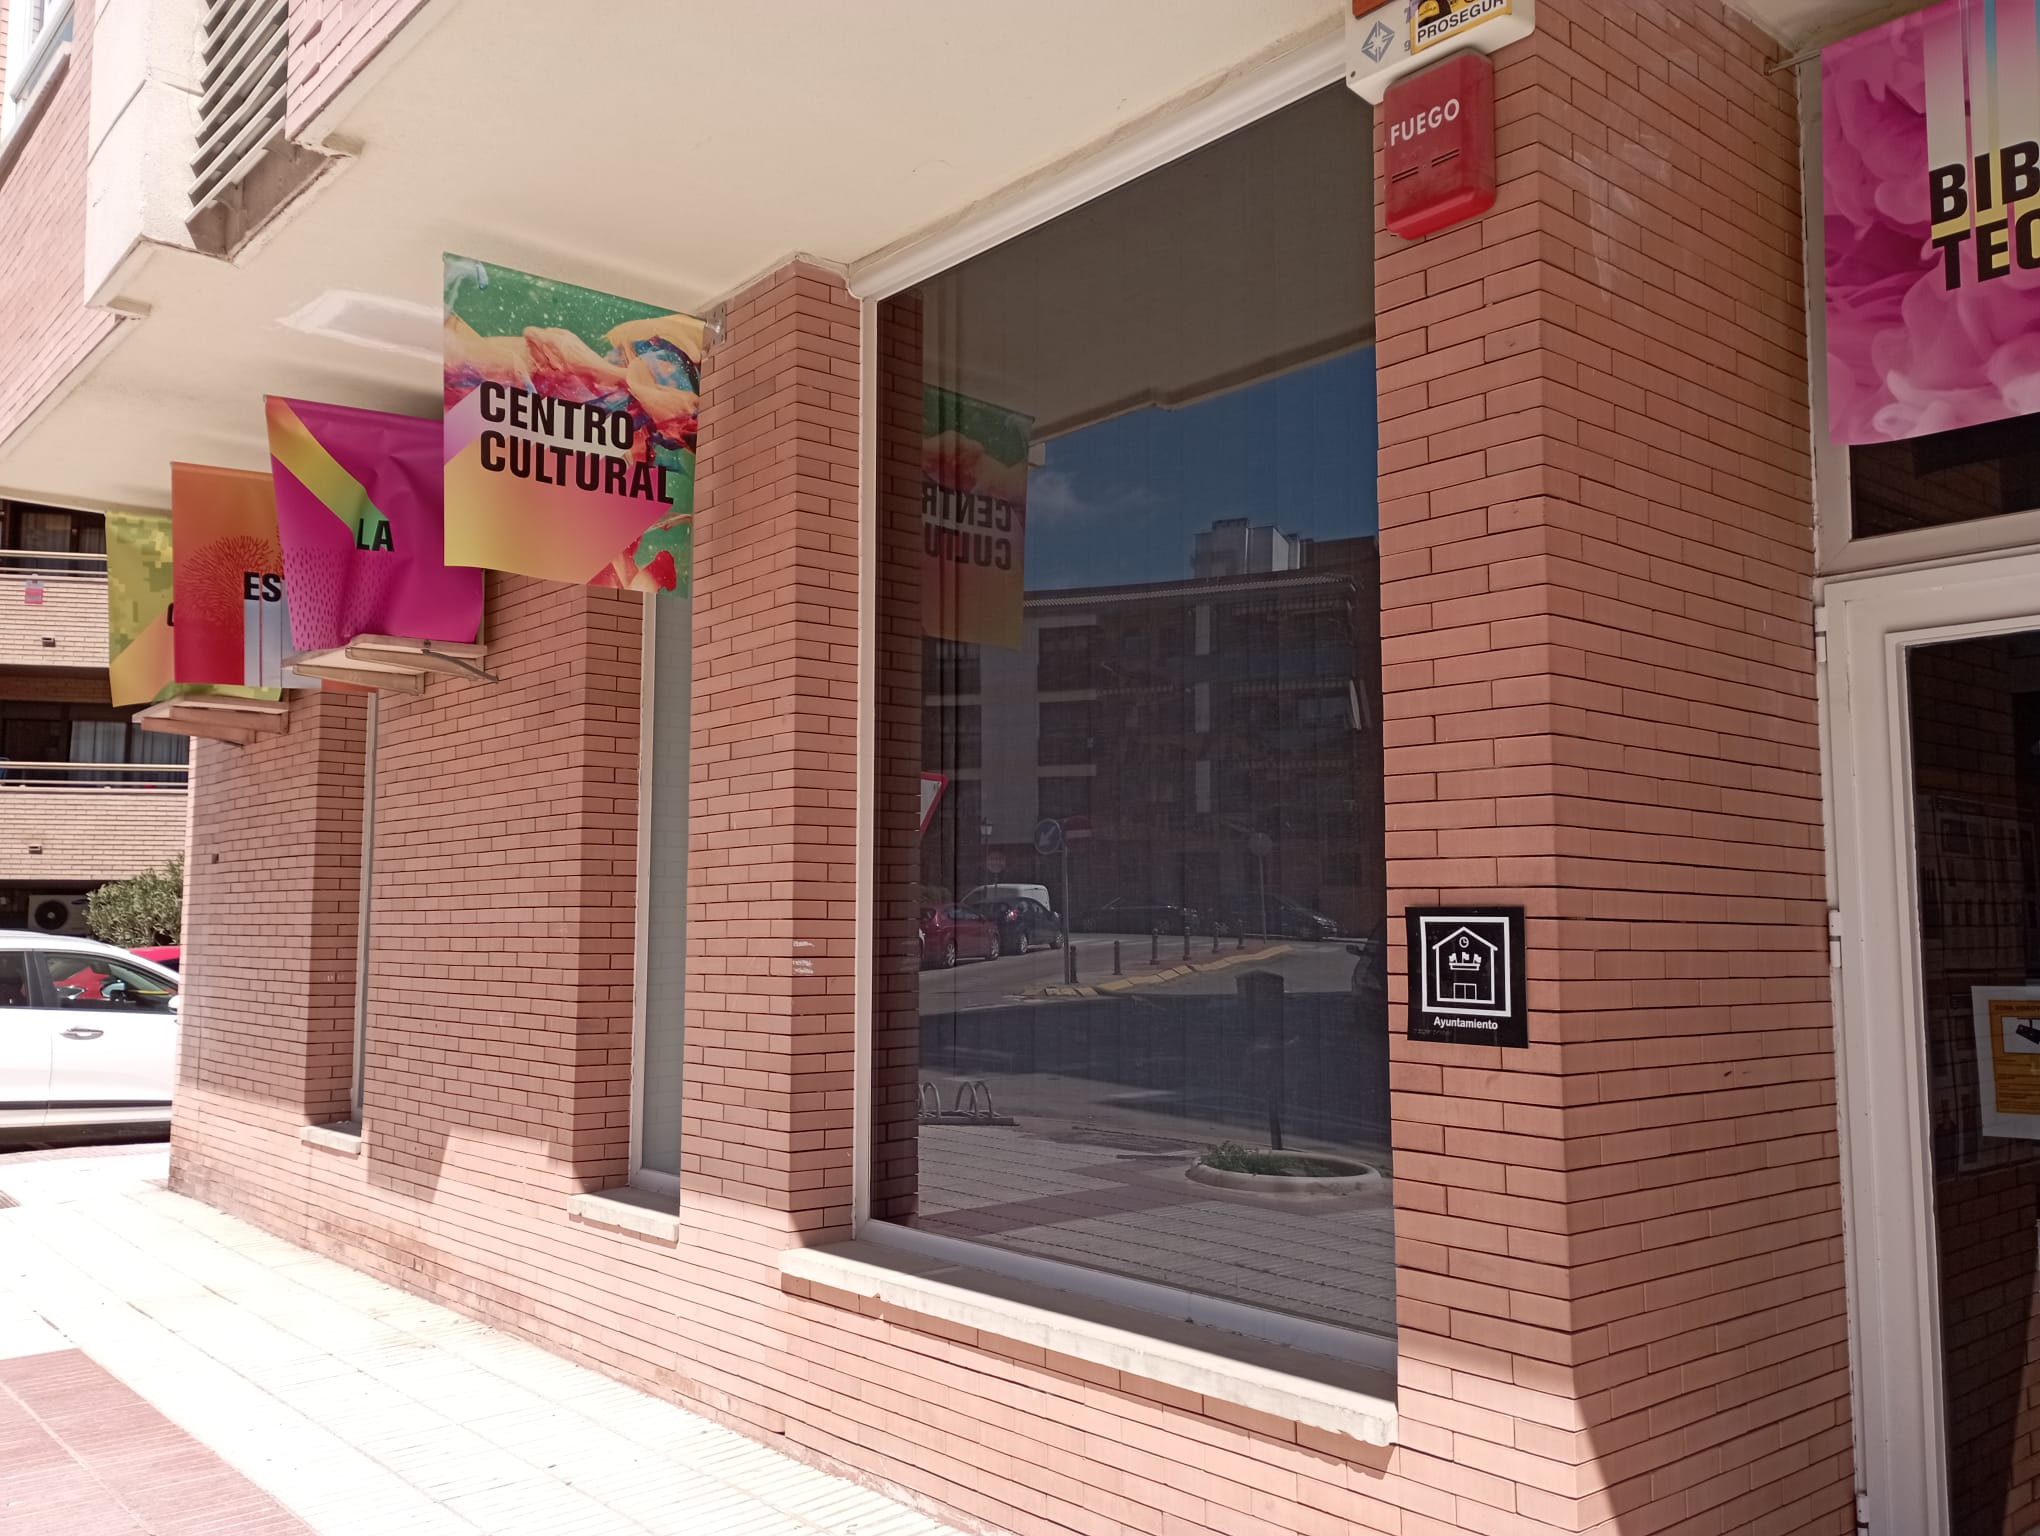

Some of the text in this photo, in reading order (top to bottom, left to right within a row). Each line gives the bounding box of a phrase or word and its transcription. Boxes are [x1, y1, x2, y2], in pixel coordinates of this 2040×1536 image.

[1390, 99, 1460, 146] FUEGO
[1929, 140, 2040, 226] BIB
[481, 382, 633, 450] CENTRO
[481, 431, 673, 504] CULTURAL
[356, 518, 394, 552] LA
[1433, 1016, 1498, 1030] Ayuntamiento
